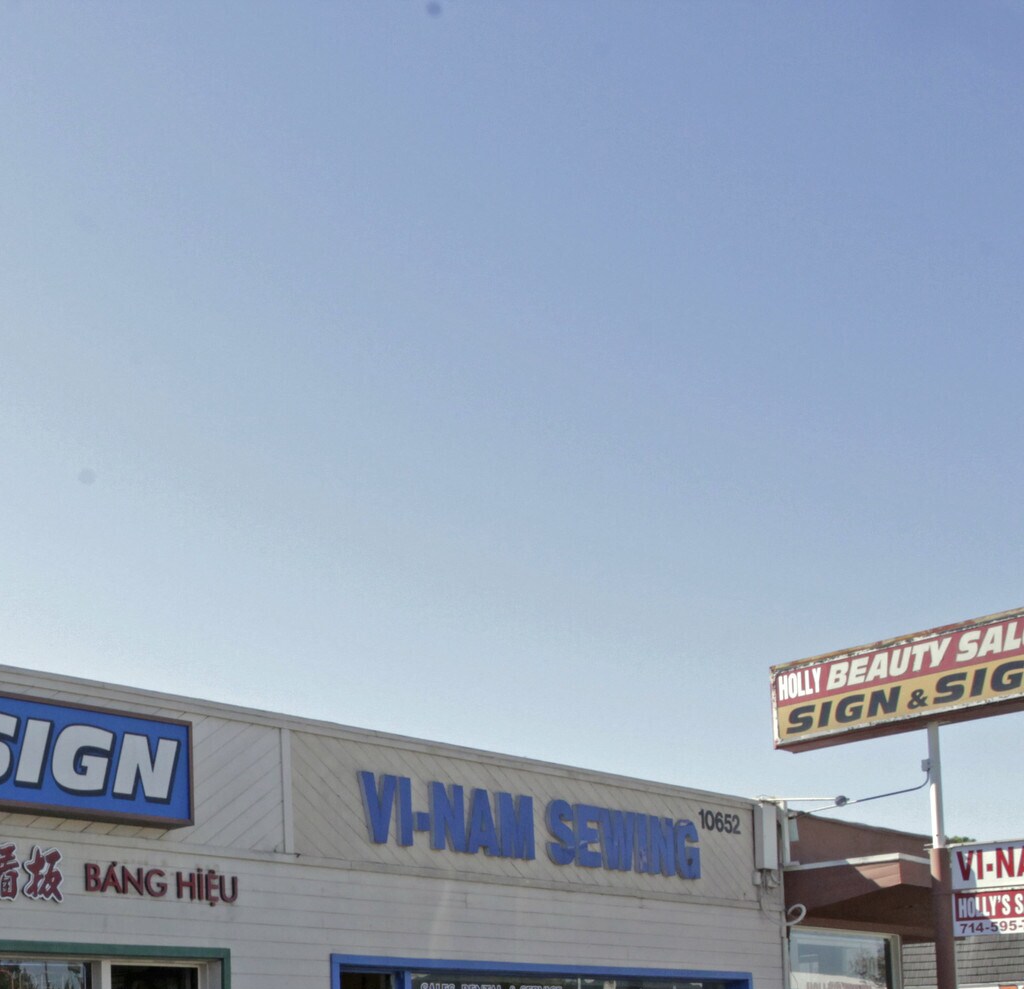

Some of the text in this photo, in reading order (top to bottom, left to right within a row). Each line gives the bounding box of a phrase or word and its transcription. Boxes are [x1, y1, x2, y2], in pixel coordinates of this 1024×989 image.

[779, 621, 1024, 701] HOLLY BEAUTY SAL
[786, 686, 901, 735] SIGN
[907, 688, 928, 710] &
[357, 770, 702, 880] VI-NAM SEWING
[698, 808, 741, 836] 10652
[958, 894, 1011, 919] HOLLY'S
[960, 920, 1024, 934] 714-595-
